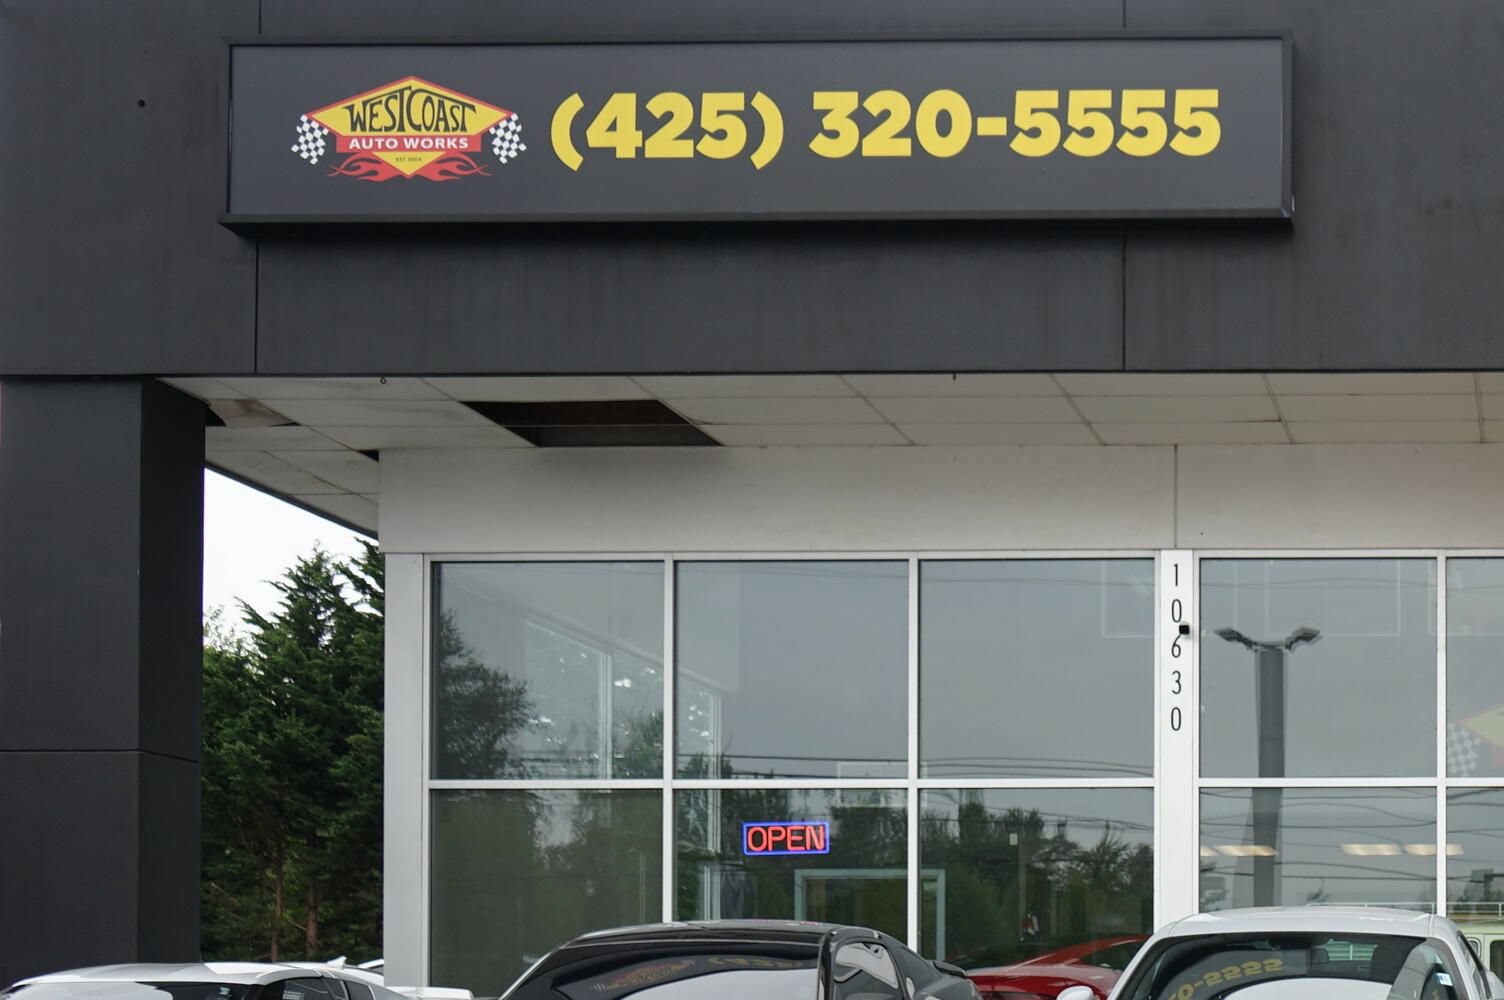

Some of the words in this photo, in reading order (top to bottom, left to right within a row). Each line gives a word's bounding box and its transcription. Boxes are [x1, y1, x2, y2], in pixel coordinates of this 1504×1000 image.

[349, 138, 398, 149] AUTO
[404, 138, 469, 149] WORKS
[551, 91, 783, 171] (425)
[809, 89, 1221, 159] 320-5555
[747, 825, 824, 852] OPEN
